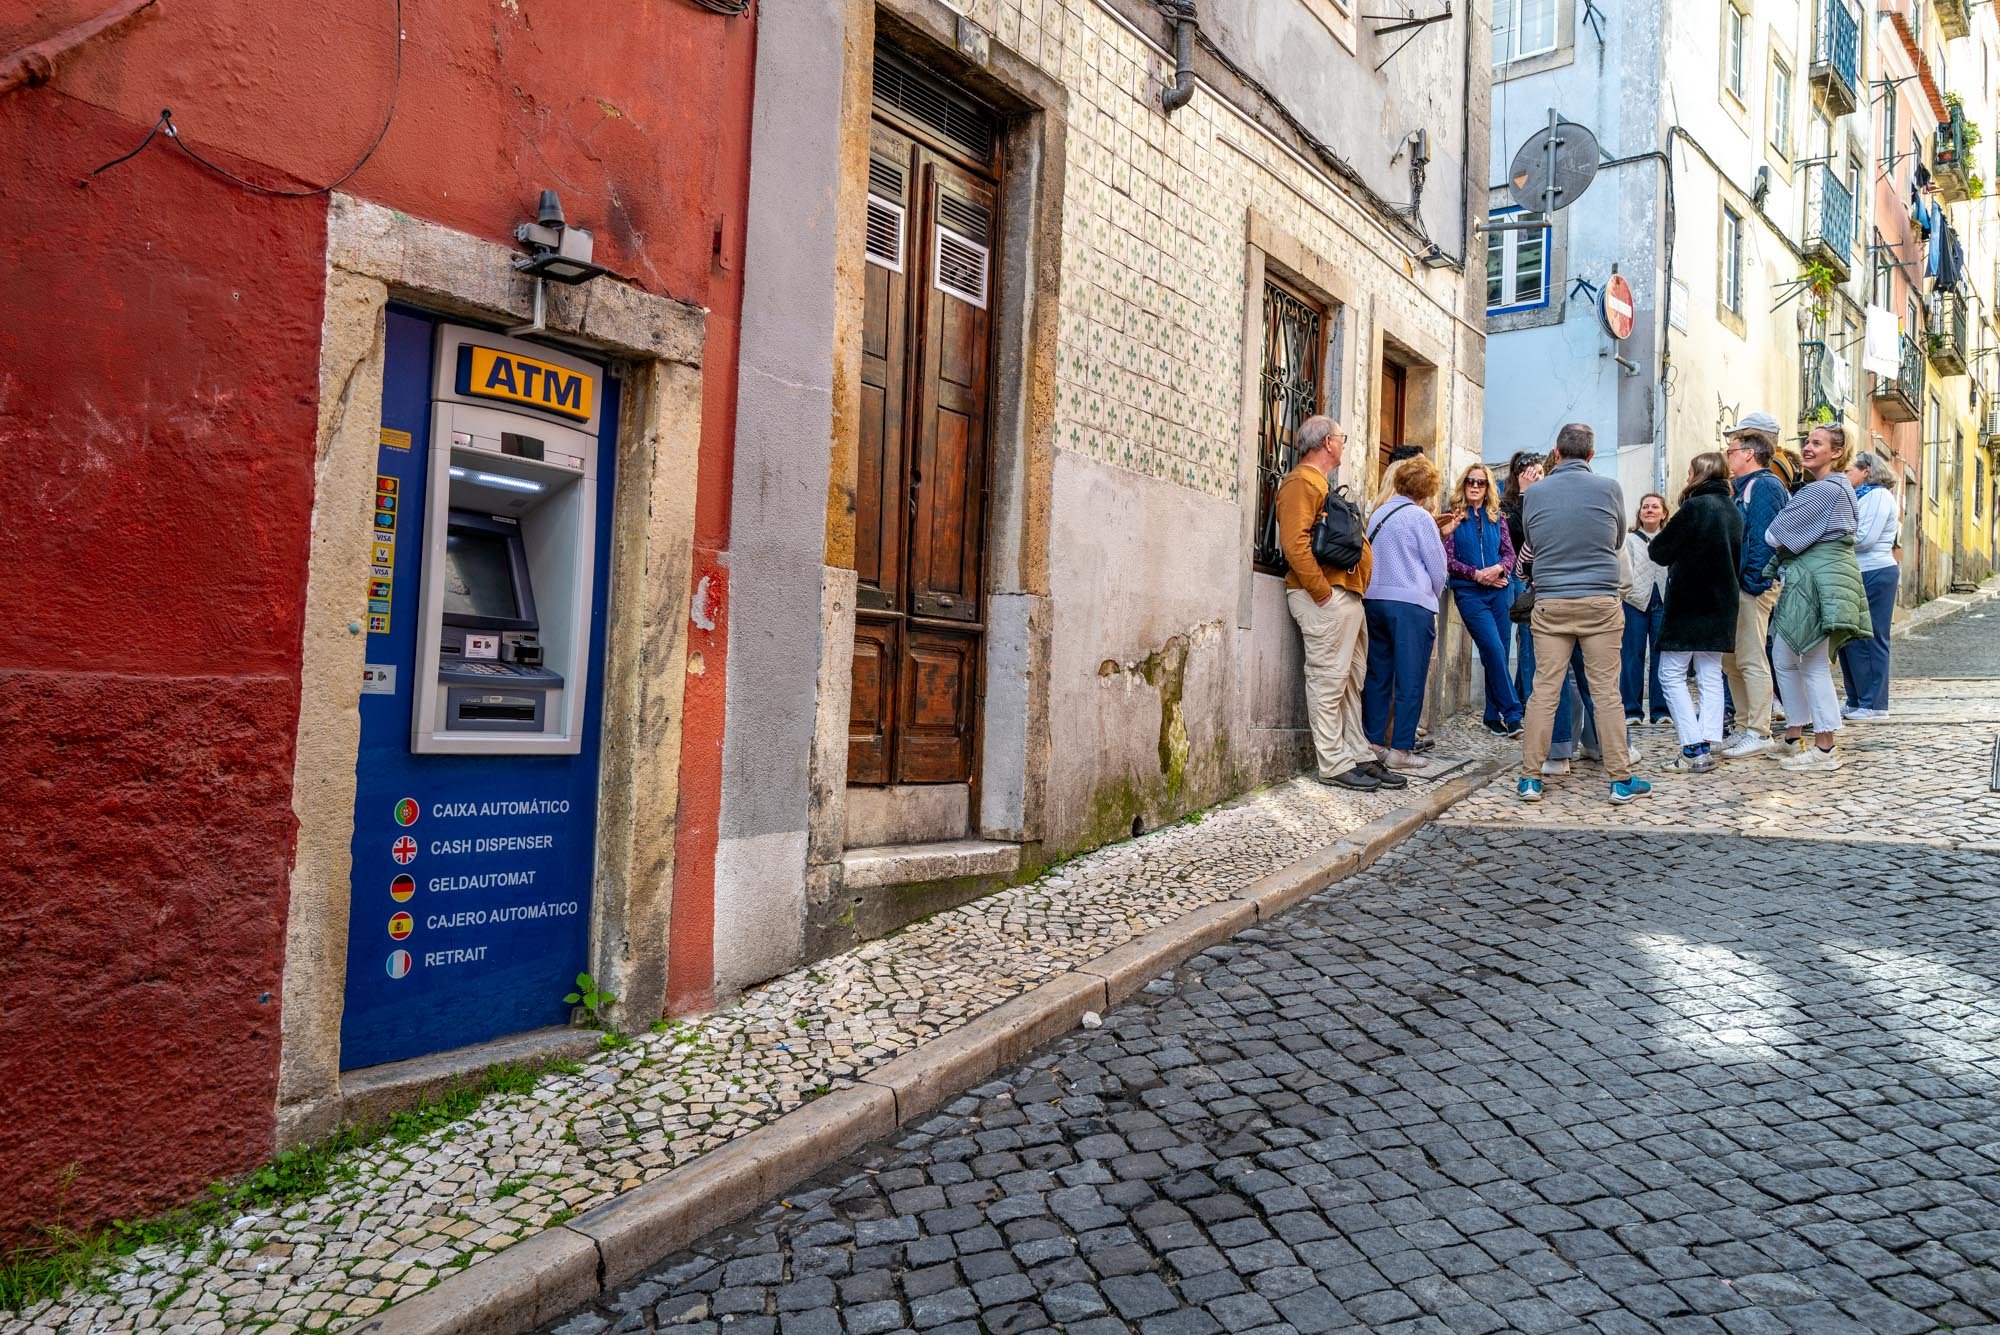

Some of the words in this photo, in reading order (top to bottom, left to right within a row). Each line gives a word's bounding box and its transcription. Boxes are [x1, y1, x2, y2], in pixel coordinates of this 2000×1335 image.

[485, 356, 582, 410] ATM
[376, 533, 392, 542] VISA
[374, 567, 389, 576] VISA
[432, 803, 477, 818] CAIXA
[480, 798, 570, 816] AUTOMÁTICO
[430, 840, 472, 855] CASH
[475, 835, 553, 852] DISPENSER
[428, 870, 536, 892] GELDAUTOMAT
[426, 911, 487, 930] CAJERO
[489, 901, 578, 923] AUTOMÁTICO
[425, 946, 488, 968] RETRAIT
